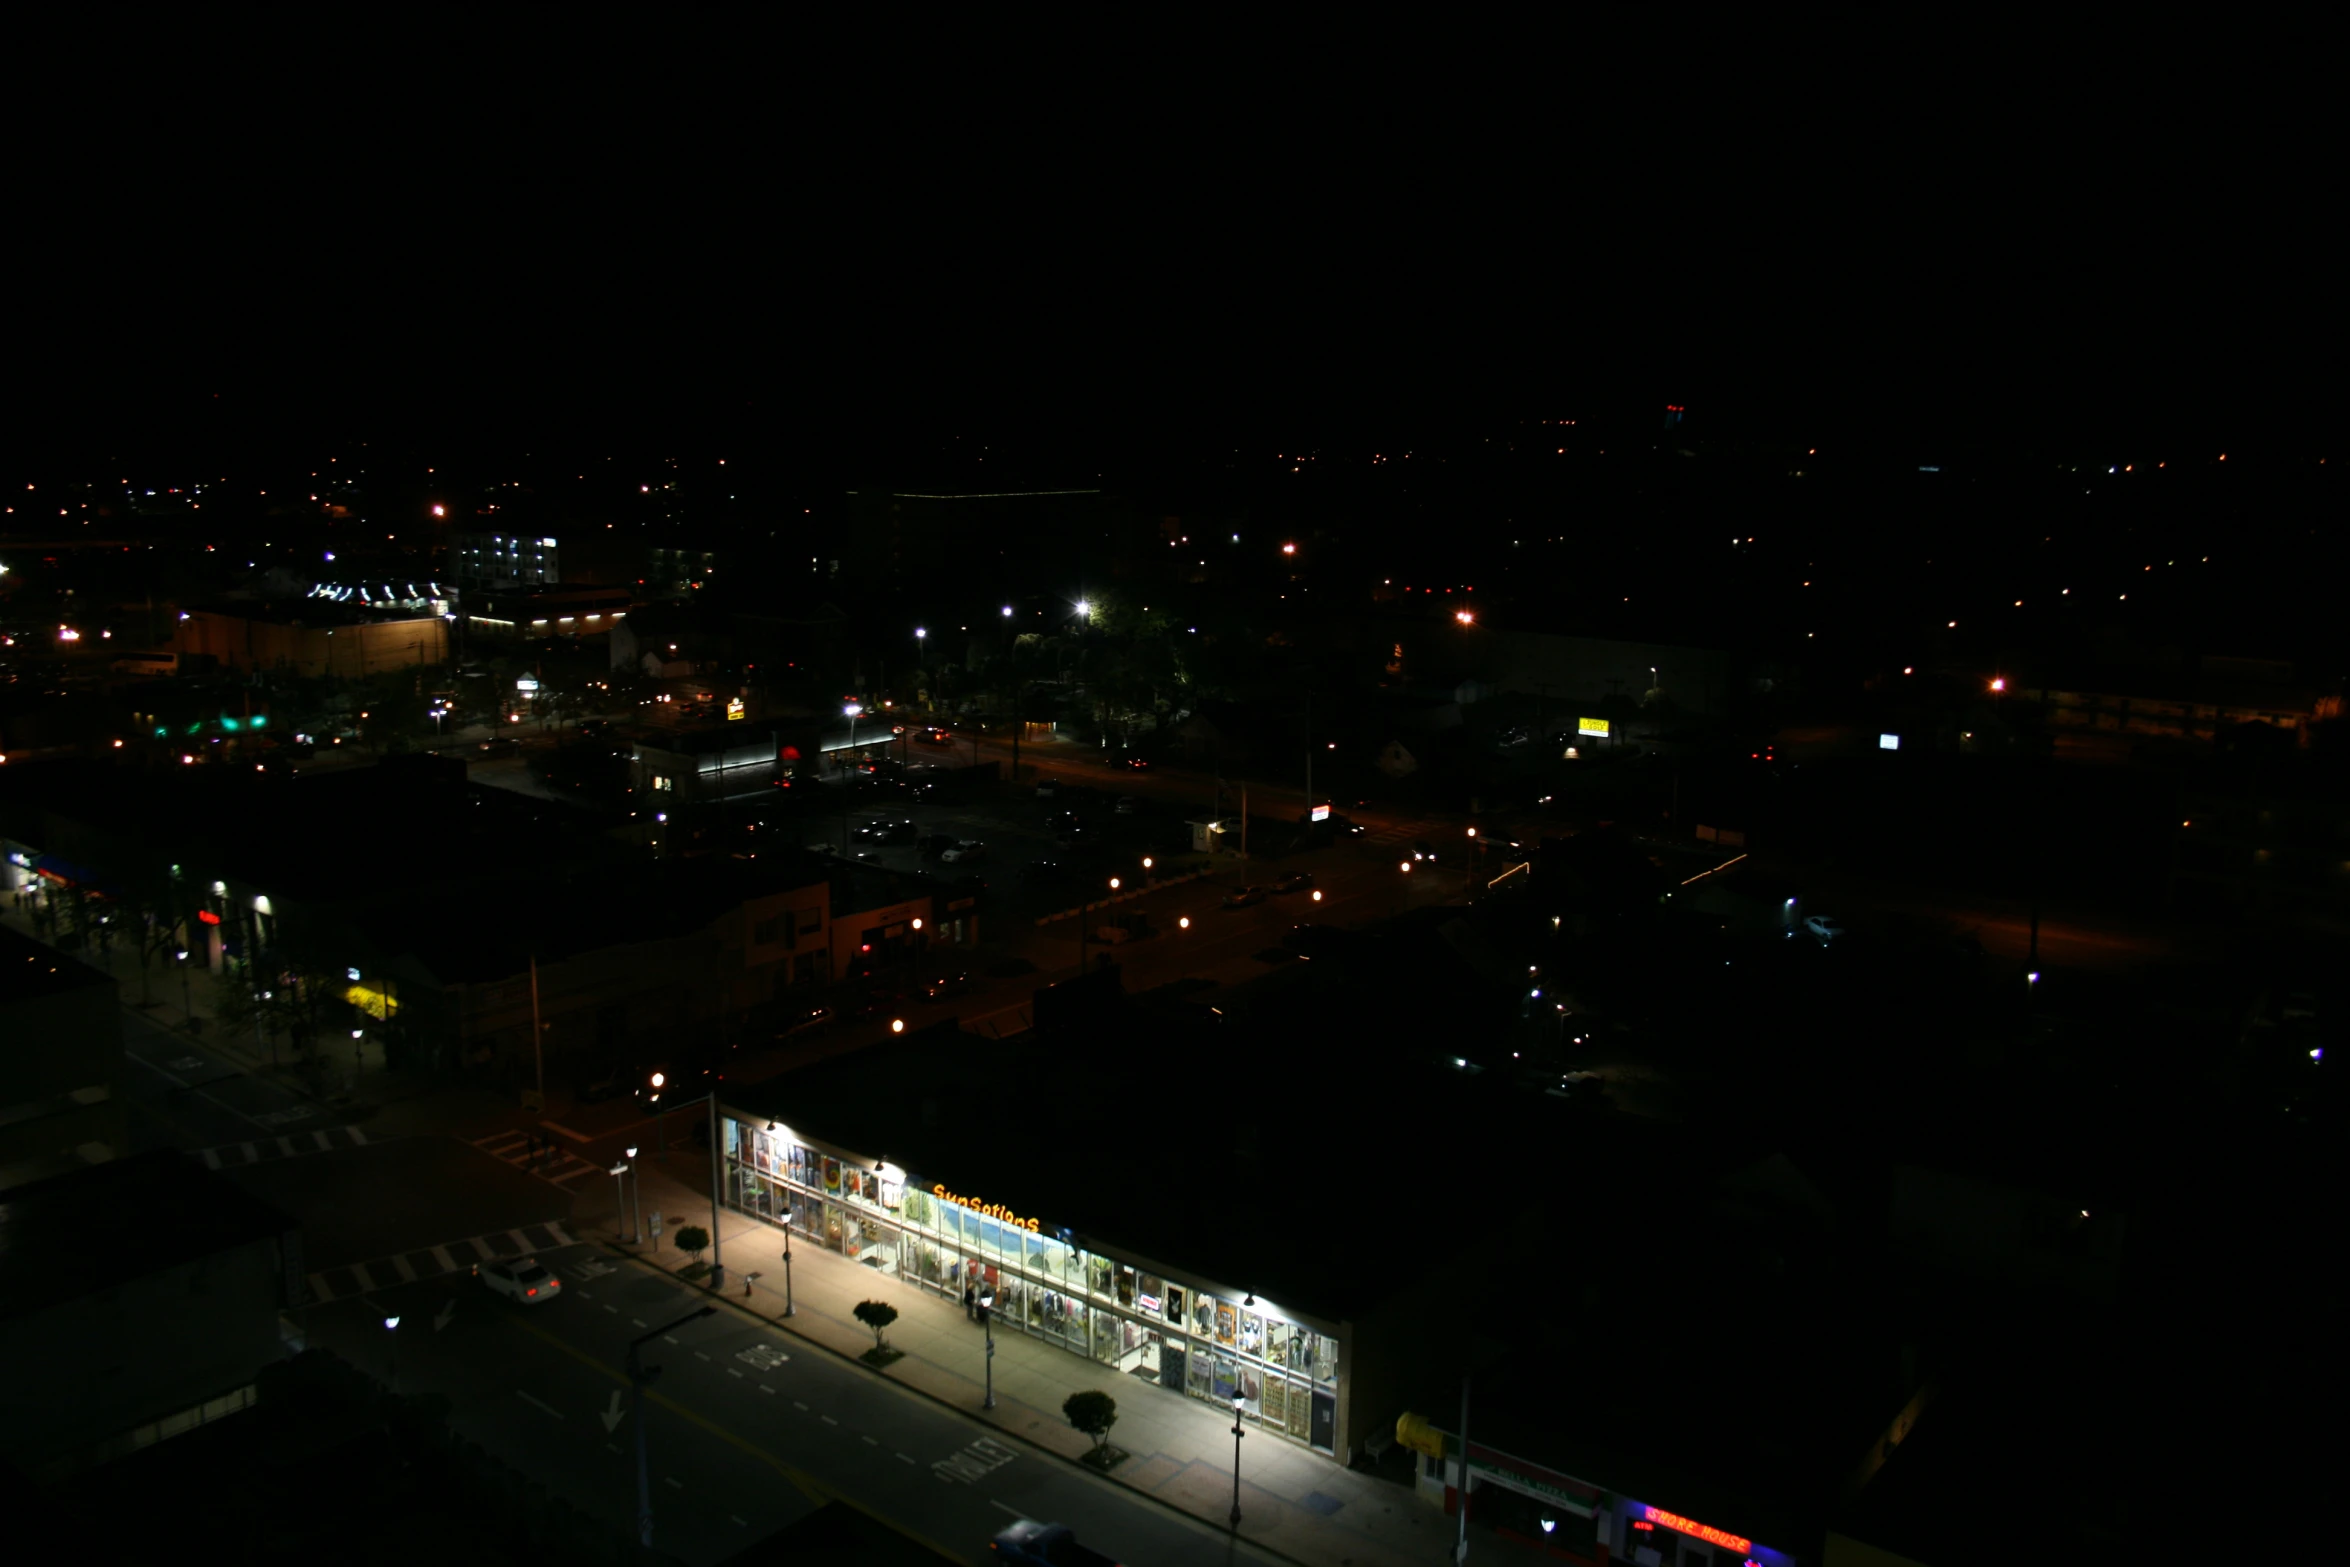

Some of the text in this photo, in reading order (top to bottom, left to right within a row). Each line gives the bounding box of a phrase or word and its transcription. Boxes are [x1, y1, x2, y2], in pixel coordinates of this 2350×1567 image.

[1498, 1467, 1532, 1487] BELLA
[1536, 1481, 1568, 1500] PIZZA
[1633, 1521, 1654, 1532] ATM
[1647, 1507, 1747, 1551] SHORE HOUSE
